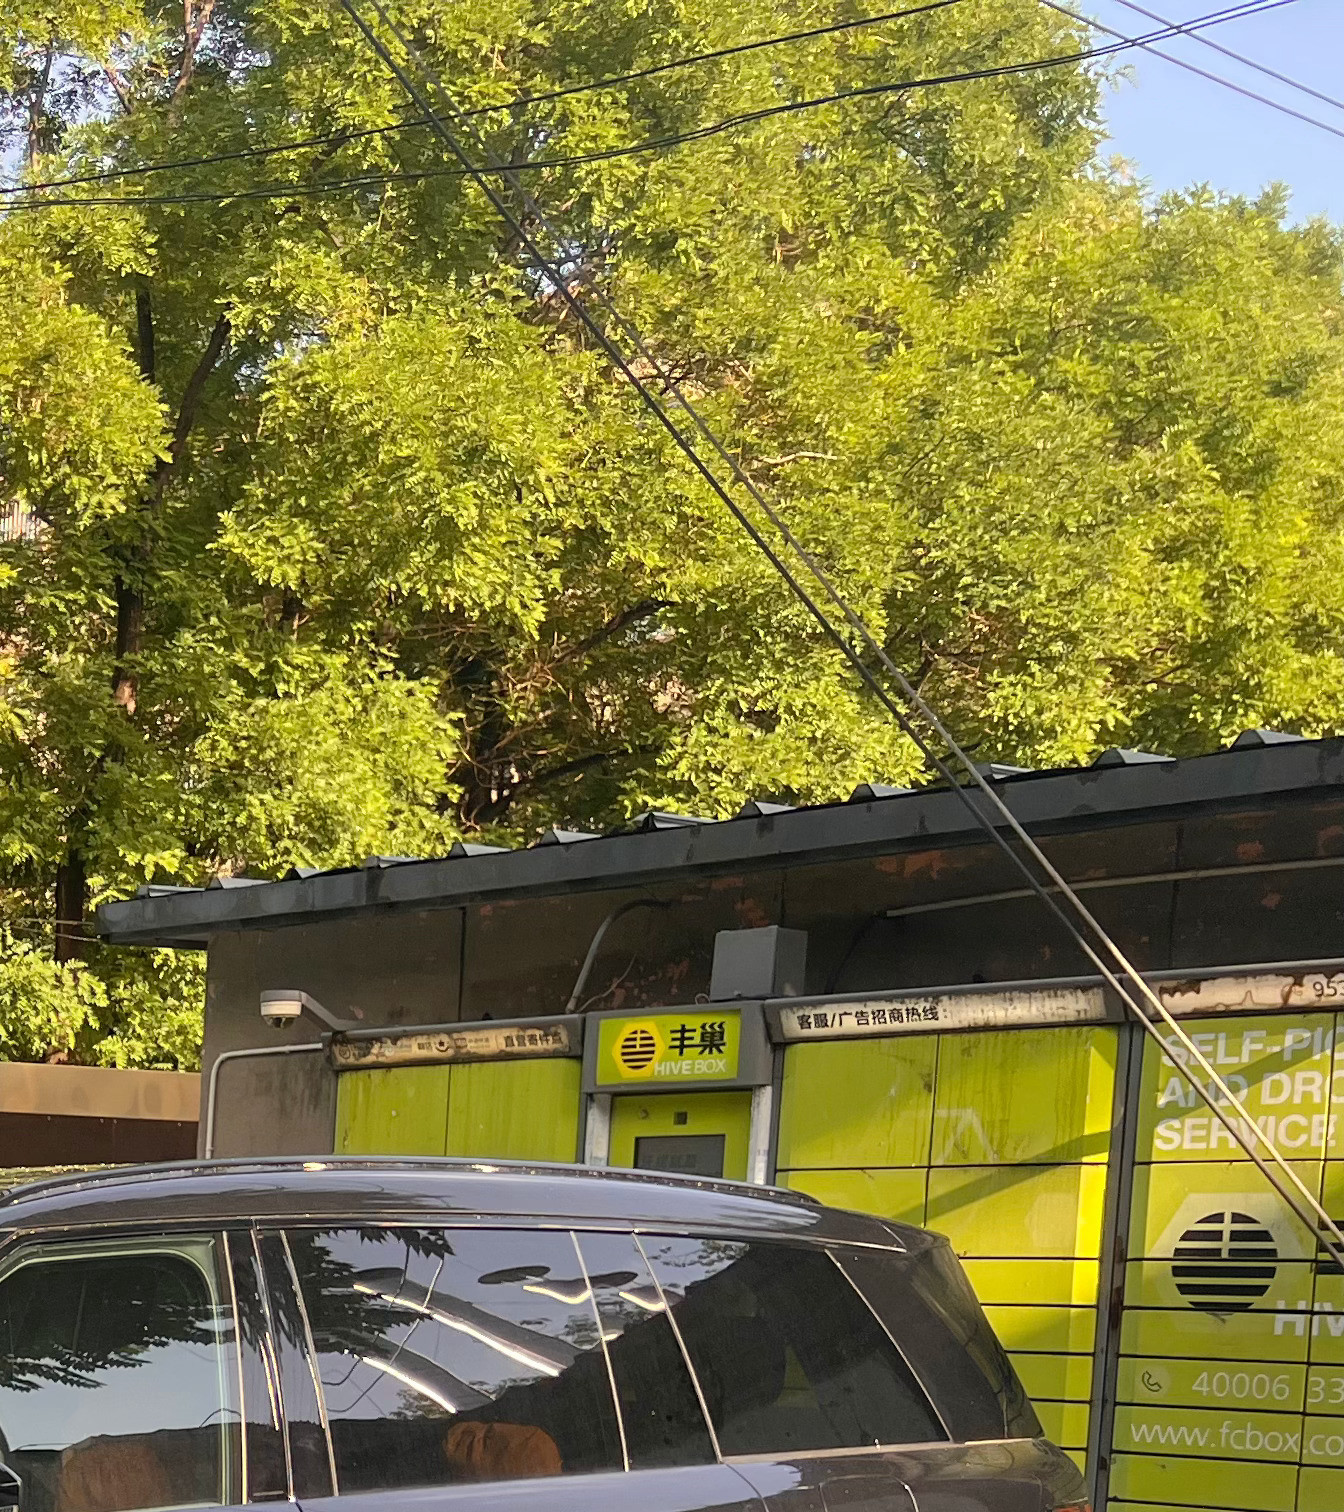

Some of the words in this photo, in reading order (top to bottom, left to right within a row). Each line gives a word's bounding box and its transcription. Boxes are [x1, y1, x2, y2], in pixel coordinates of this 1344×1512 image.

[668, 1021, 727, 1056] 丰巢
[654, 1060, 691, 1076] HIVE
[694, 1059, 727, 1073] BOX
[1155, 1113, 1337, 1150] SERVICE
[1192, 1371, 1290, 1400] 40006
